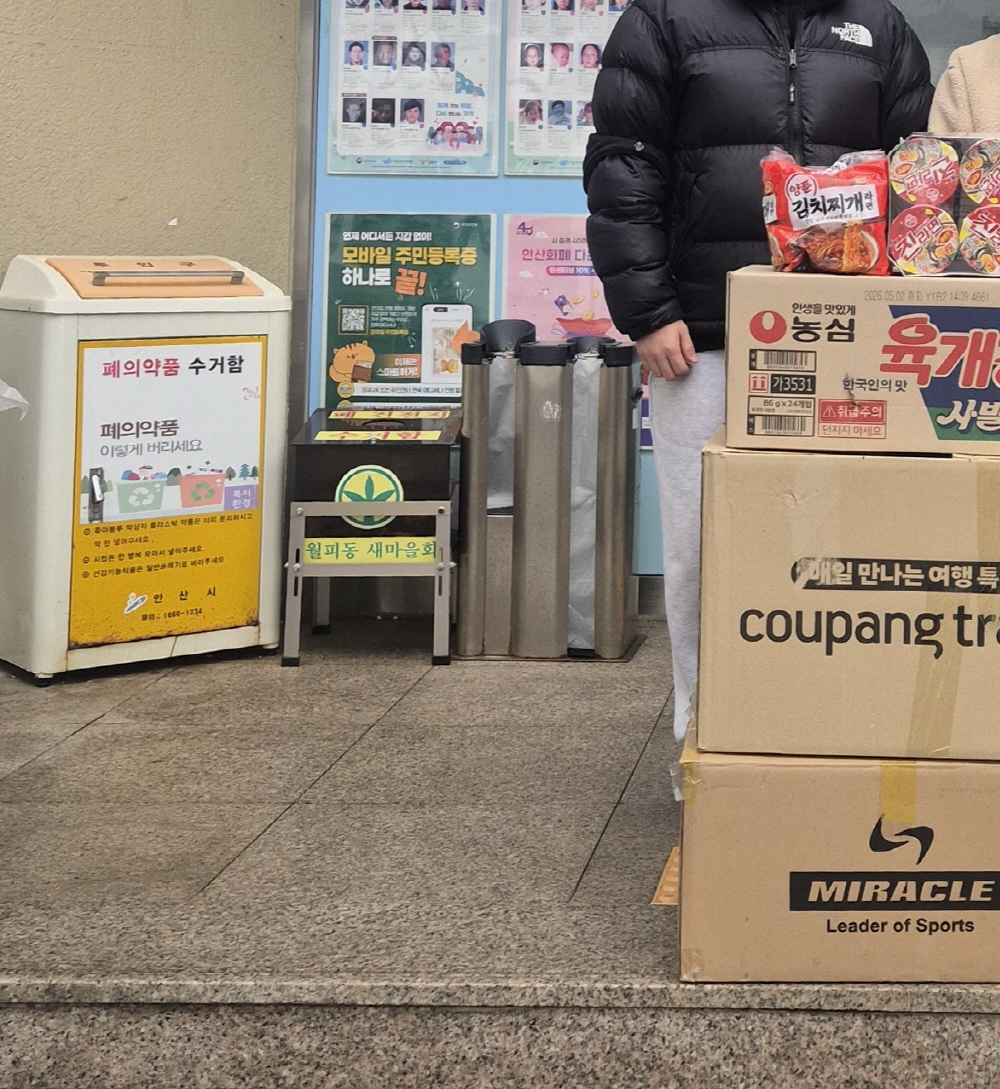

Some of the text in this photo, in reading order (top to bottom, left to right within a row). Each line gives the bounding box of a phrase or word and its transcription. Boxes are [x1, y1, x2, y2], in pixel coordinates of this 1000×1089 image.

[789, 179, 813, 197] 양푼
[791, 191, 864, 219] 김치찌개
[863, 190, 874, 211] 라면
[342, 231, 432, 242] 언제 어디서든 지갑 없이!
[895, 214, 945, 262] 진라면
[342, 246, 478, 266] 모바일 주민등록증
[521, 248, 571, 261] 안산화폐
[341, 267, 428, 297] 하나로 끝!
[863, 289, 906, 301] 2026.05.02
[792, 302, 857, 316] 인생을 맛있게
[791, 315, 856, 344] 농심
[102, 354, 245, 379] 폐의약품 수거함
[394, 357, 418, 366] 이제는
[376, 367, 419, 377] 스마트하게!
[772, 376, 814, 392] 가3531
[842, 377, 908, 393] 한국인의 맛
[836, 404, 882, 419] 취급주의
[100, 419, 180, 440] 폐의약품
[822, 424, 882, 437] 던지지 마세요
[100, 439, 203, 458] 이렇게 버리세요
[231, 488, 251, 498] 복지
[231, 499, 251, 510] 환경
[305, 540, 437, 561] 월피동 새마을회
[857, 562, 925, 588] 만나는
[928, 563, 973, 589] 여행
[739, 607, 945, 660] coupang
[807, 879, 996, 904] MIRACLE
[826, 917, 975, 937] Leader of Sports
